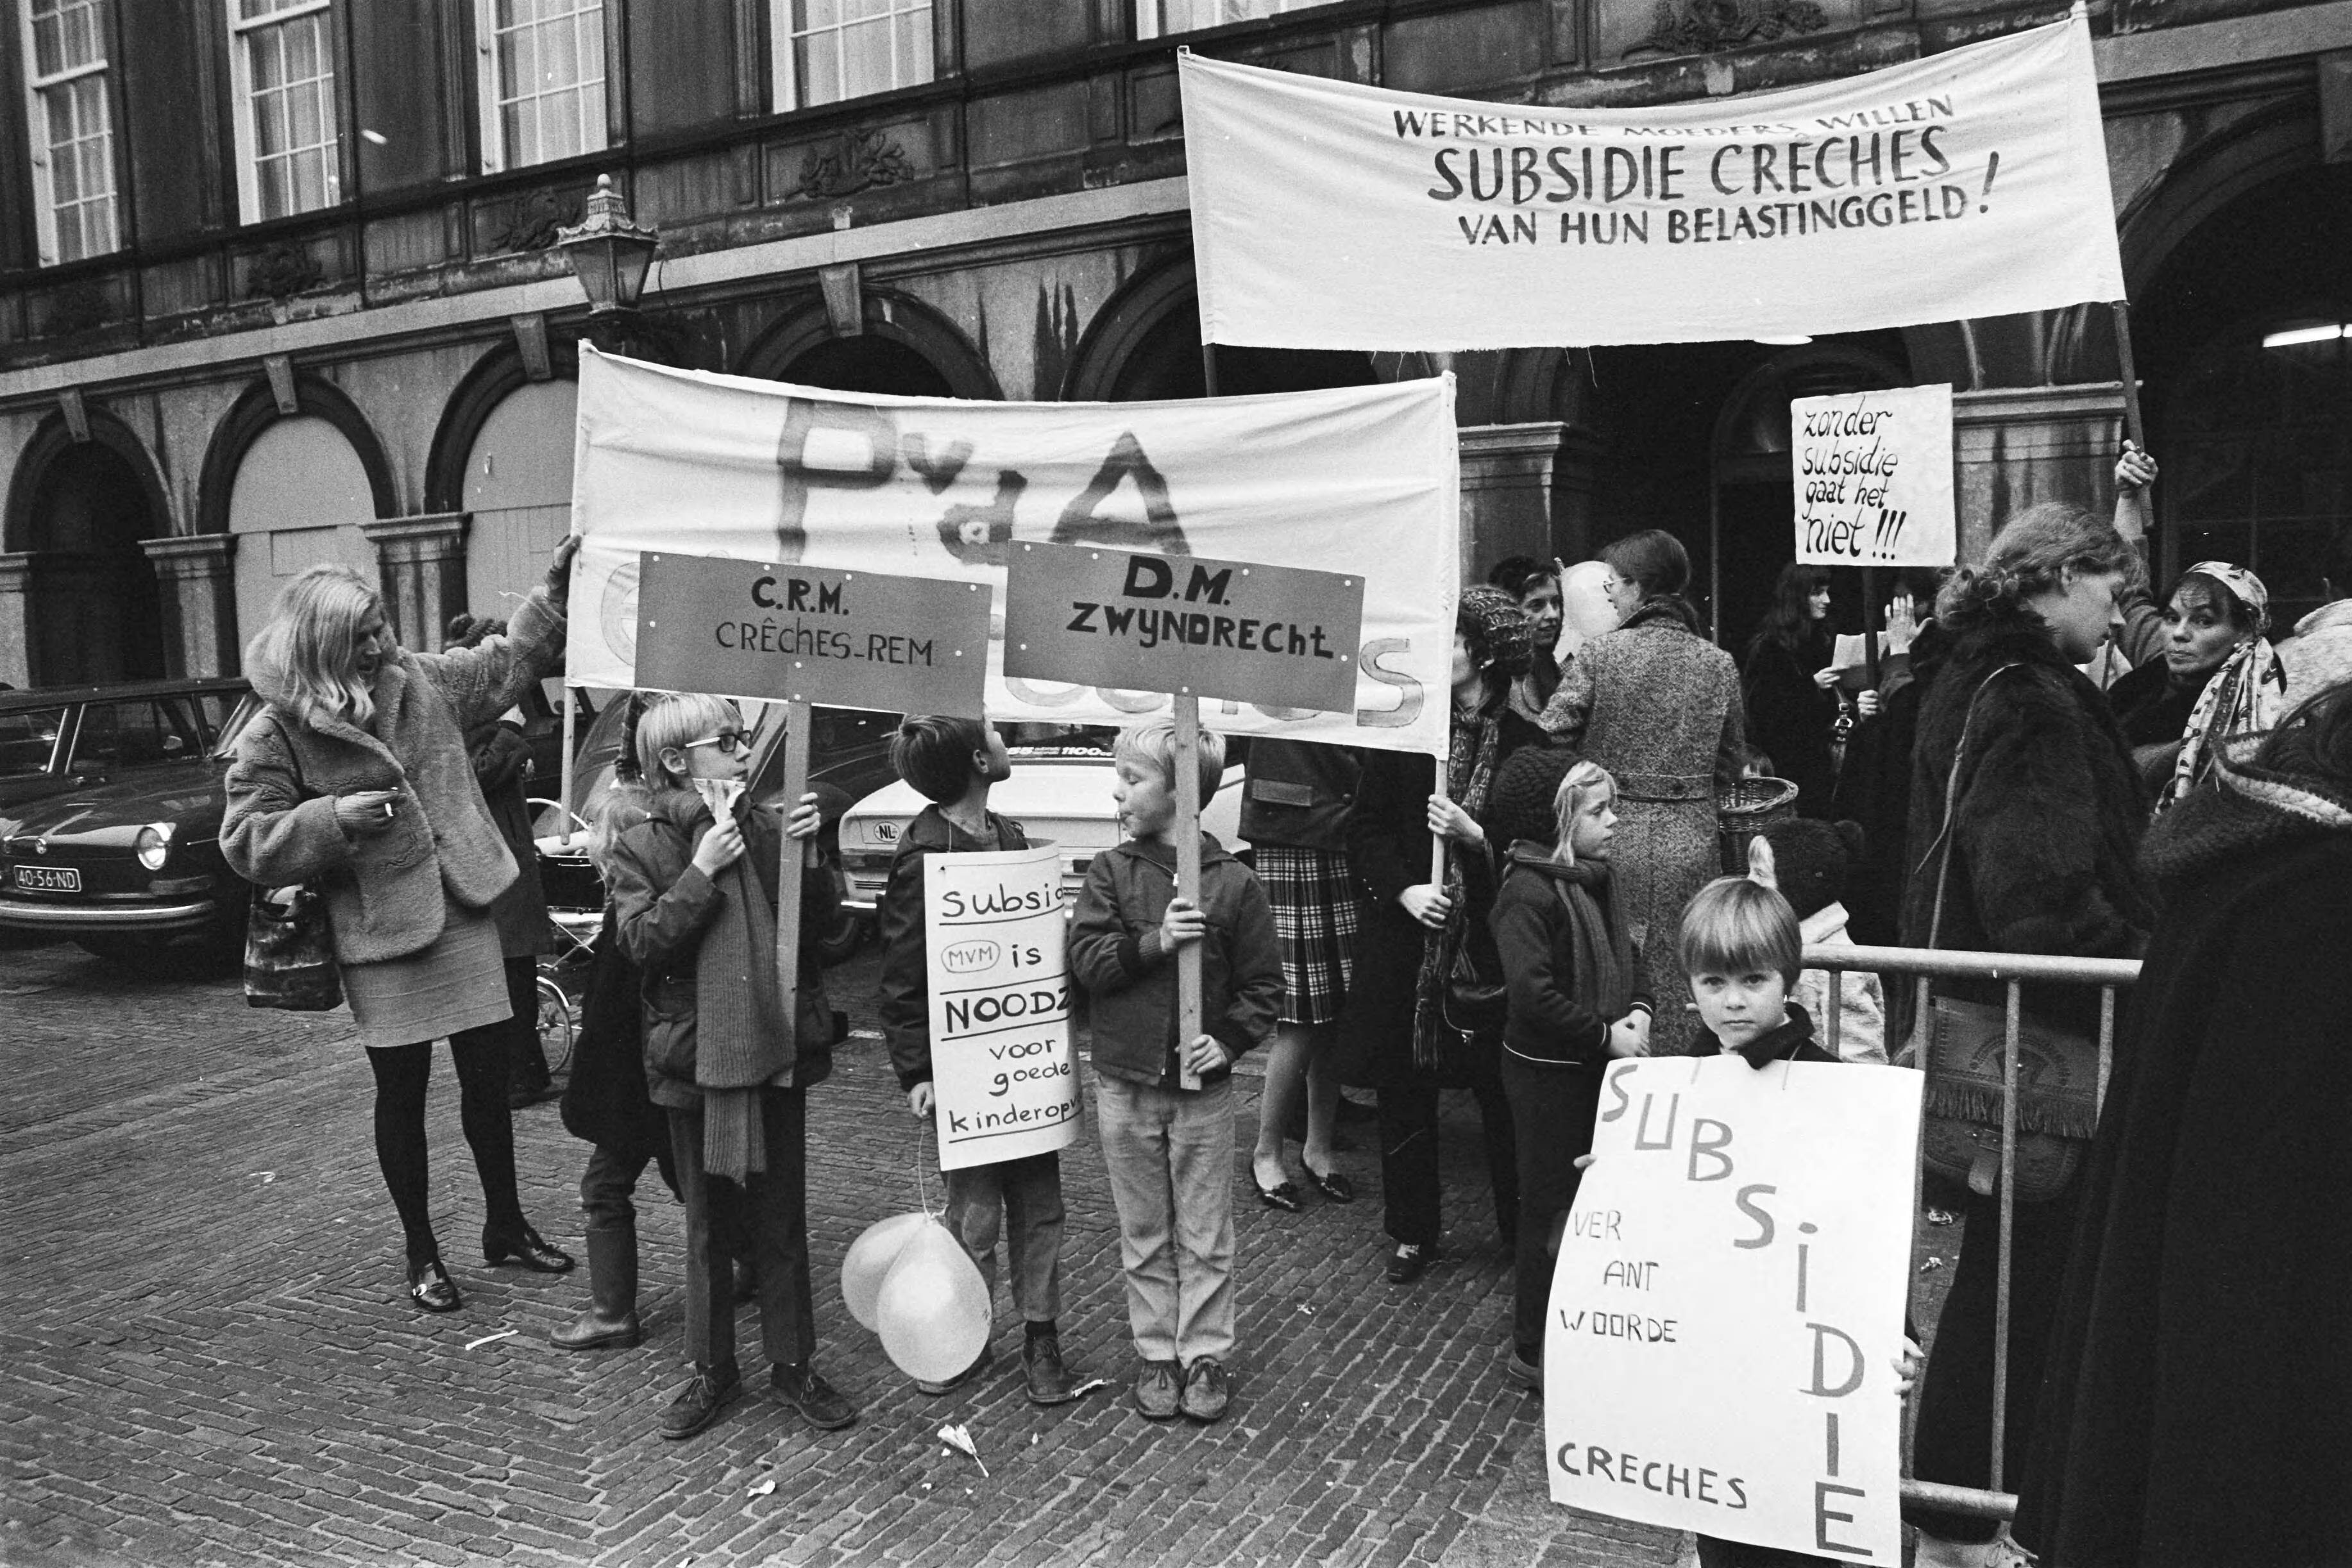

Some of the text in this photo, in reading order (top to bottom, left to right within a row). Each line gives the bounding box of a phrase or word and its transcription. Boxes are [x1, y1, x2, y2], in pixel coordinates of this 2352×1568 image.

[1393, 110, 1602, 138] WERKENDE
[1816, 94, 1954, 129] WILLEN
[1428, 145, 1686, 205] SUBSIDIE
[1458, 212, 1537, 245] VAN
[1561, 210, 1648, 245] HUN
[1803, 395, 1893, 437] zonder
[1802, 436, 1899, 477] subsidie
[1802, 476, 1890, 520] gaat het
[751, 576, 850, 616] C.R.M.
[1122, 555, 1232, 606] D.M.
[879, 825, 896, 839] NL
[19, 870, 76, 888] 40-56-ND
[949, 944, 1042, 968] MVM is
[989, 1039, 1056, 1060] voor
[988, 1061, 1071, 1097] goede
[1575, 1210, 1621, 1241] VER
[1603, 1260, 1659, 1291] ANT
[1560, 1309, 1678, 1343] WOORDE
[1557, 1442, 1747, 1509] CRECHES
